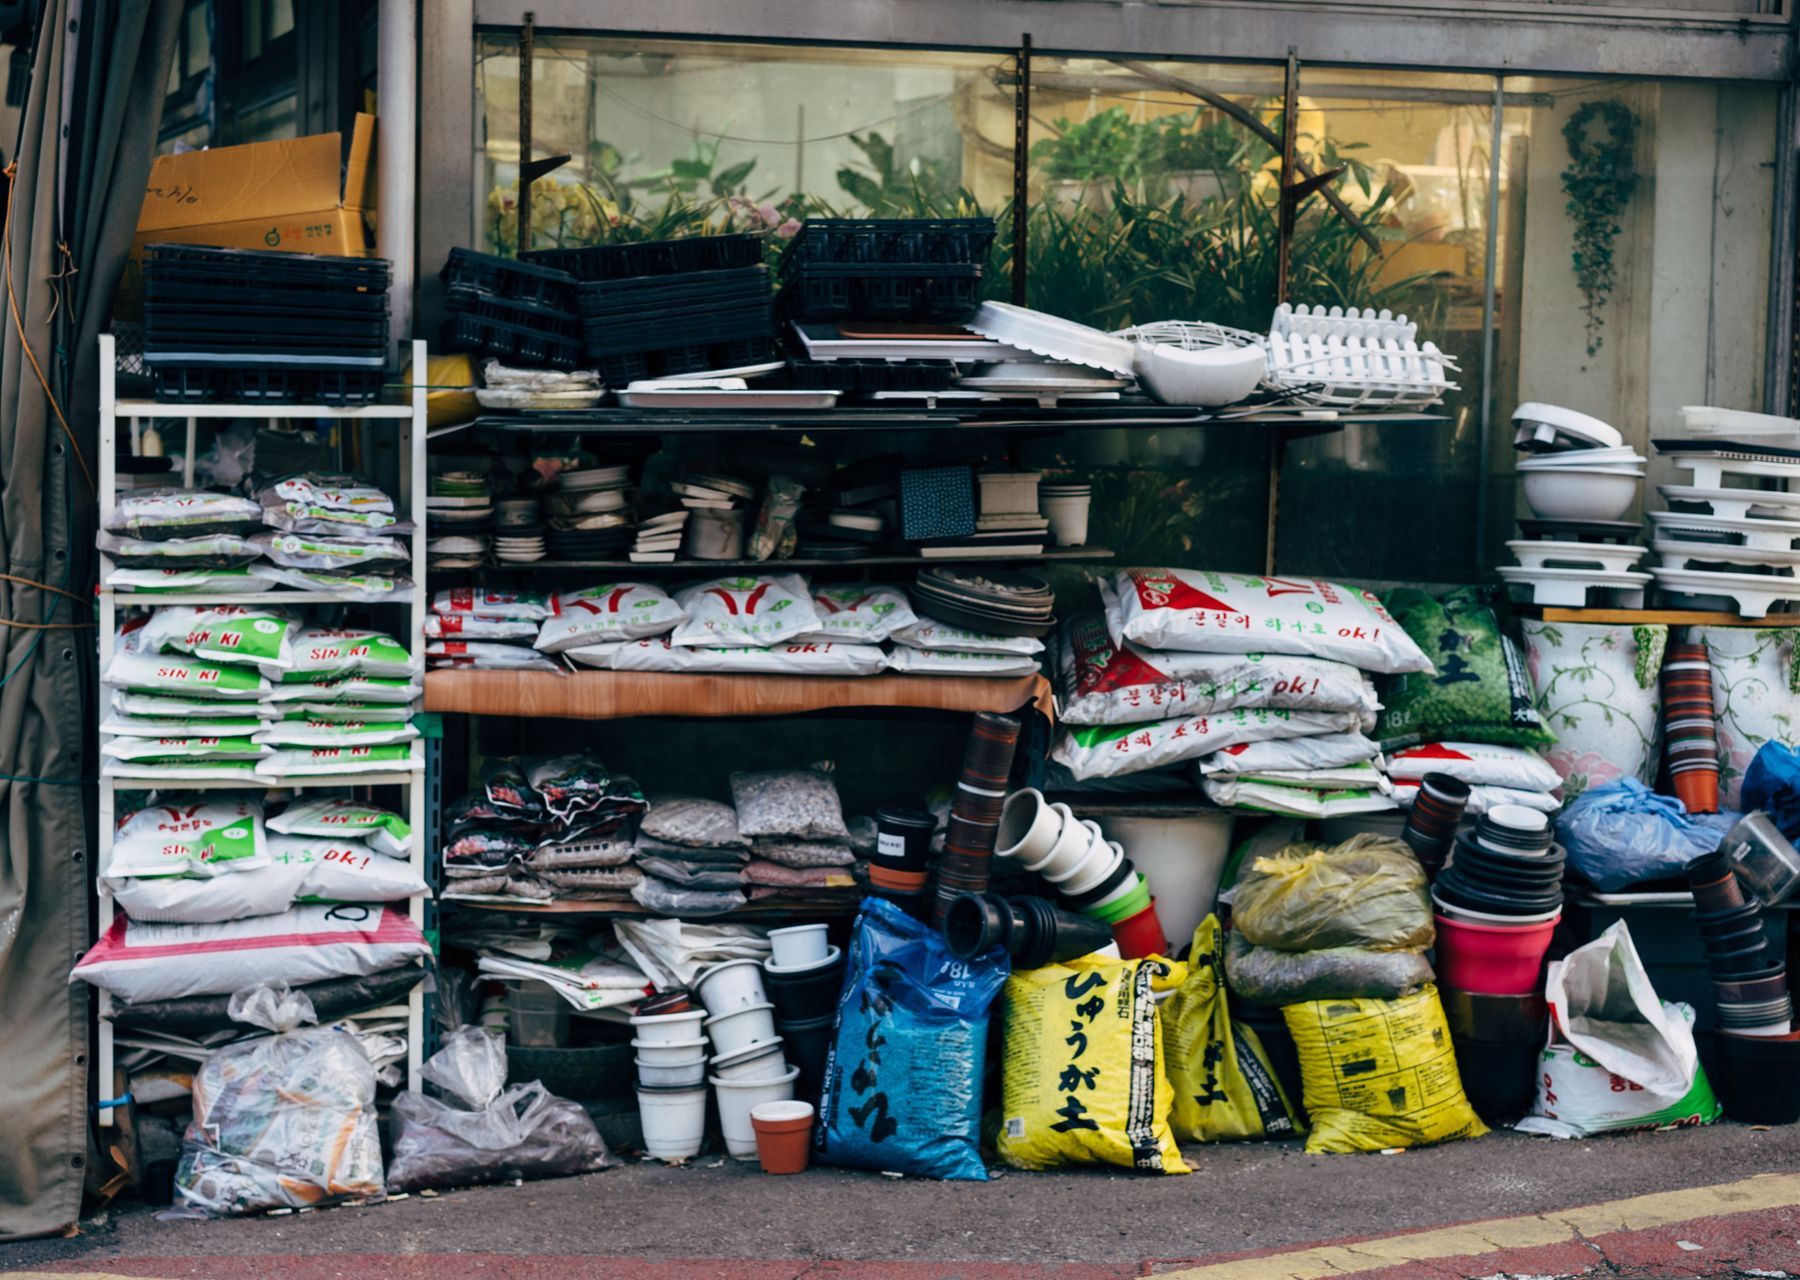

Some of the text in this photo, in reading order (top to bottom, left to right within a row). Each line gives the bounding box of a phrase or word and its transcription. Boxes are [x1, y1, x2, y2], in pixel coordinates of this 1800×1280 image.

[185, 631, 241, 646] SIN KI
[310, 646, 369, 660] SIN KI
[158, 668, 219, 680] SIN KI
[273, 849, 316, 865] 나로
[1050, 971, 1108, 1134] ひゅうが土
